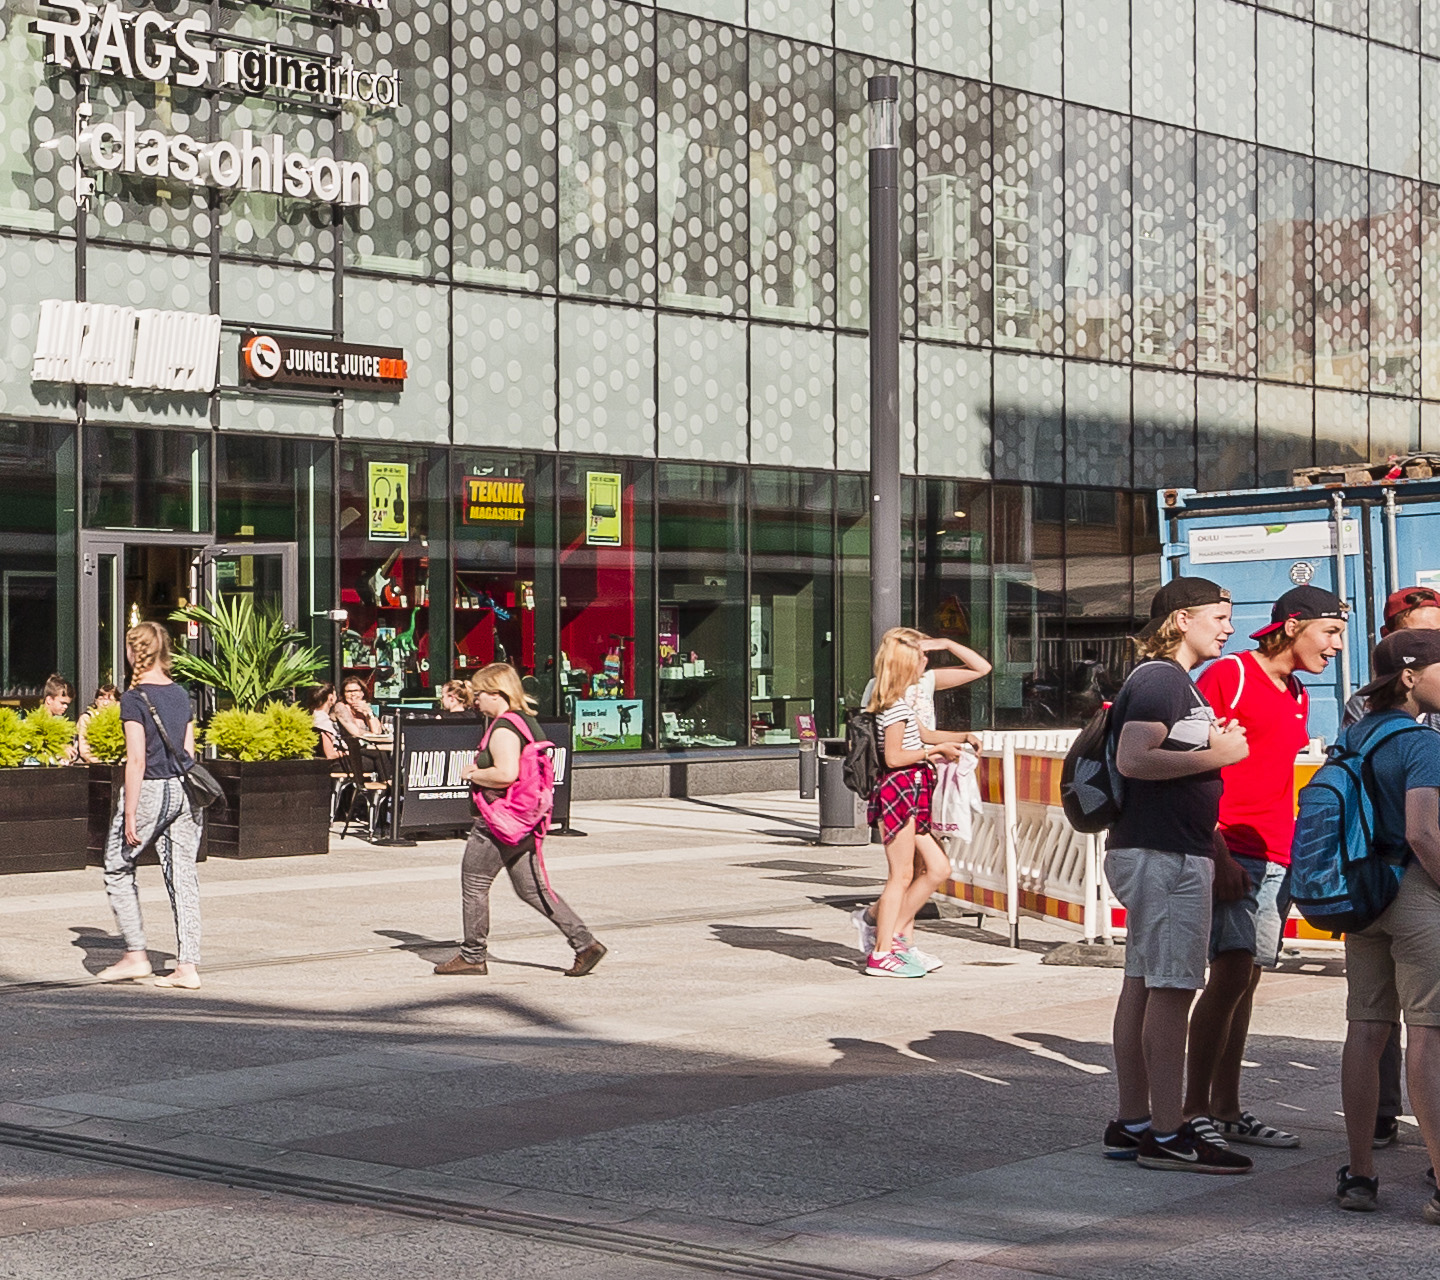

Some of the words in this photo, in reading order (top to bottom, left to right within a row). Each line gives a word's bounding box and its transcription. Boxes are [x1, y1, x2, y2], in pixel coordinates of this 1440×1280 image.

[82, 111, 198, 184] clas
[205, 128, 371, 206] ohlson
[286, 348, 339, 374] JUNGLE
[341, 354, 380, 377] JUICE
[470, 480, 525, 504] TEKNIK
[470, 505, 525, 521] MAGASINET
